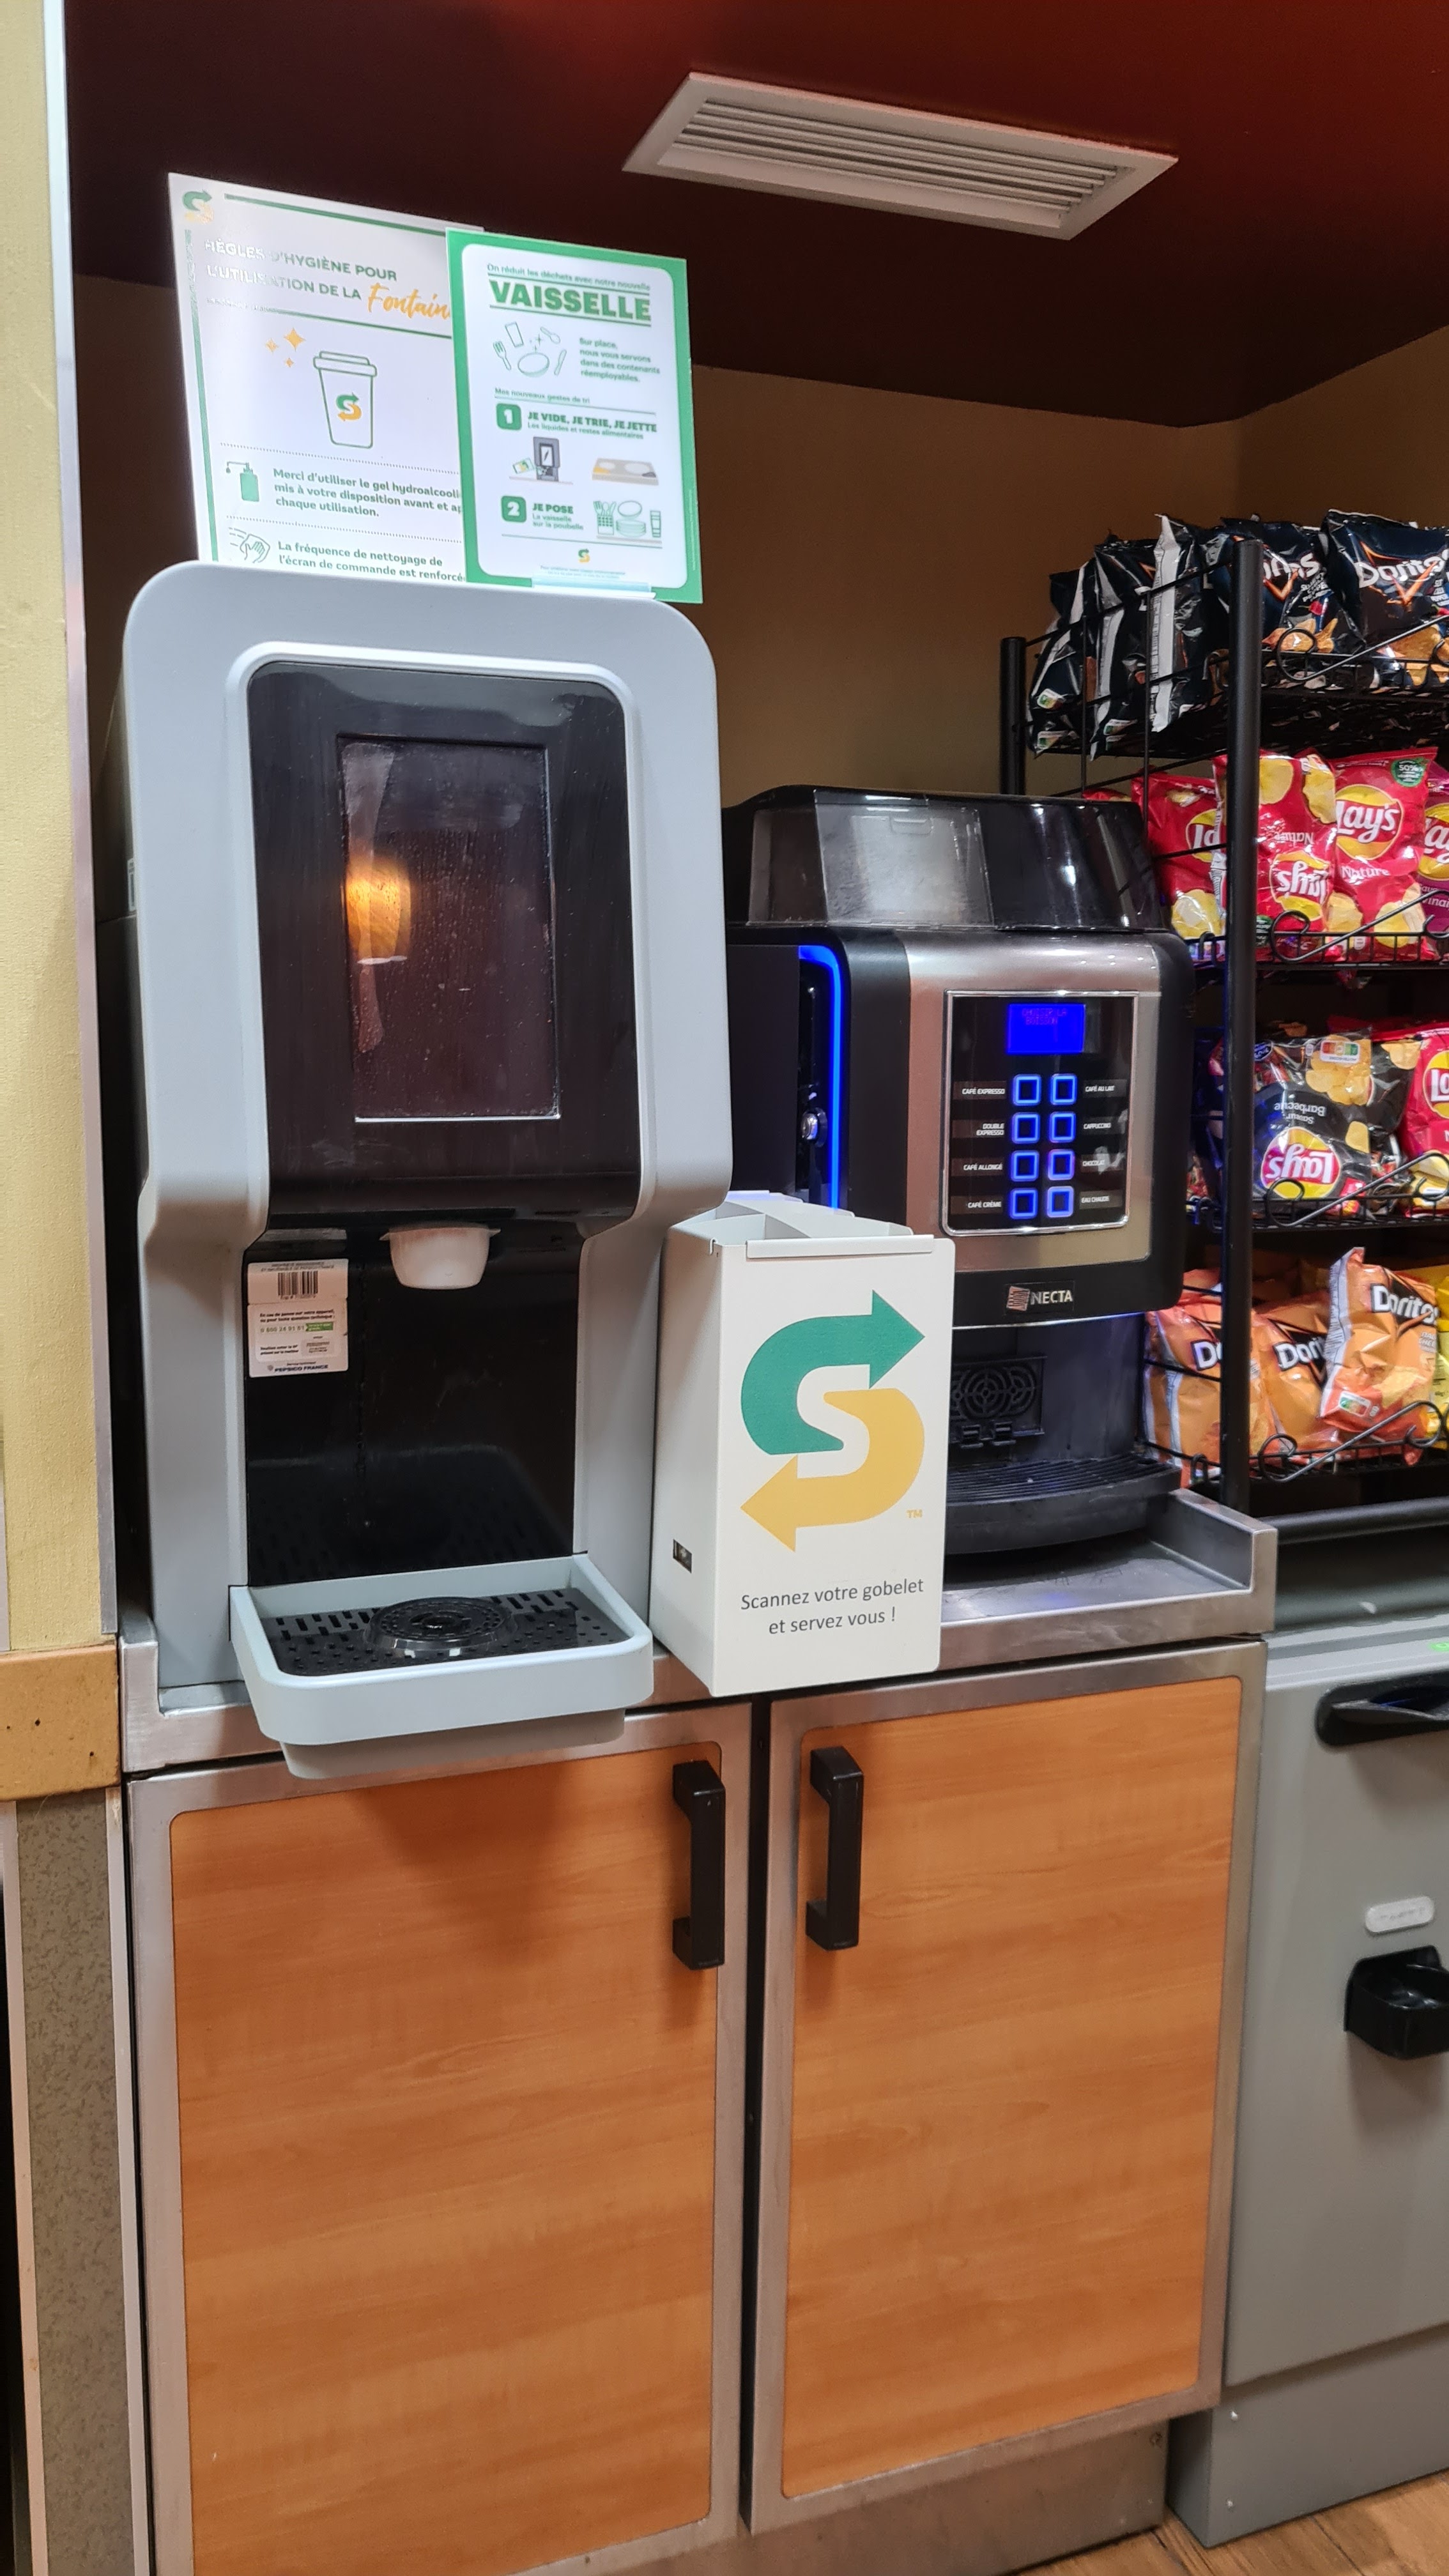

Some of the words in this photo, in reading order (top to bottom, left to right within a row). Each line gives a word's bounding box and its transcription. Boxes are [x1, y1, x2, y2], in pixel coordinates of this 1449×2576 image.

[270, 251, 351, 273] D'HYGIÈNE
[355, 264, 397, 282] POUR
[487, 263, 500, 272] On
[501, 265, 526, 276] réduit
[528, 268, 539, 277] les
[541, 269, 572, 281] déchets
[575, 275, 592, 284] avec
[595, 277, 616, 288] notre
[618, 280, 650, 291] nouvelle
[319, 286, 339, 297] DE
[343, 289, 362, 300] LA
[367, 282, 450, 319] Fontain
[489, 280, 652, 321] VAISSELLE
[579, 337, 593, 346] Sur
[594, 340, 618, 350] place,
[580, 349, 599, 358] nous
[601, 351, 618, 360] vous
[621, 354, 651, 364] servons
[580, 358, 599, 367] dans
[601, 360, 615, 370] des
[617, 363, 661, 375] contenants
[581, 370, 641, 384] réemployables.
[494, 387, 510, 396] Mes
[511, 390, 545, 400] nouveaux
[548, 394, 571, 403] gestes
[572, 395, 582, 403] de
[503, 409, 513, 424] 1
[528, 411, 540, 421] JE
[541, 413, 569, 424] VIDE,
[572, 415, 584, 425] JE
[586, 417, 612, 429] TRIE,
[614, 420, 626, 429] JE
[627, 420, 657, 433] JETTE
[541, 422, 569, 434] liquides
[579, 427, 600, 436] restes
[602, 429, 643, 440] alimentaires
[273, 468, 305, 482] Merci
[307, 471, 356, 489] d'utiliser
[360, 478, 370, 488] le
[373, 479, 390, 491] gel
[392, 482, 461, 500] hydroalcooli
[274, 483, 295, 493] mis
[298, 484, 303, 494] à
[307, 487, 337, 498] votre
[340, 489, 401, 507] disposition
[403, 499, 434, 509] avant
[437, 502, 448, 512] et
[275, 497, 317, 510] chaque
[319, 502, 379, 518] utilisation.
[532, 502, 545, 512] JE
[546, 503, 574, 514] POSE
[507, 502, 520, 517] 2
[532, 513, 542, 521] La
[543, 514, 572, 523] vaisselle
[548, 520, 554, 528] la
[556, 521, 584, 531] poubelle
[278, 541, 291, 551] La
[294, 542, 350, 558] fréquence
[353, 548, 367, 558] de
[370, 551, 427, 567] nettoyage
[429, 555, 442, 567] de
[279, 554, 316, 567] l'écran
[319, 558, 333, 569] de
[335, 562, 395, 576] commande
[399, 567, 416, 578] est
[419, 569, 466, 582] renforcé
[1337, 800, 1402, 844] Lay's
[1341, 866, 1390, 881] Nature
[1266, 1144, 1333, 1183] Lay's
[1031, 1290, 1073, 1305] NECTA
[740, 1590, 809, 1611] Scannez
[815, 1584, 858, 1603] votre
[862, 1578, 924, 1602] gobelet
[769, 1618, 786, 1635] et
[790, 1613, 843, 1633] servez
[847, 1609, 885, 1627] vous
[891, 1606, 896, 1622] !
